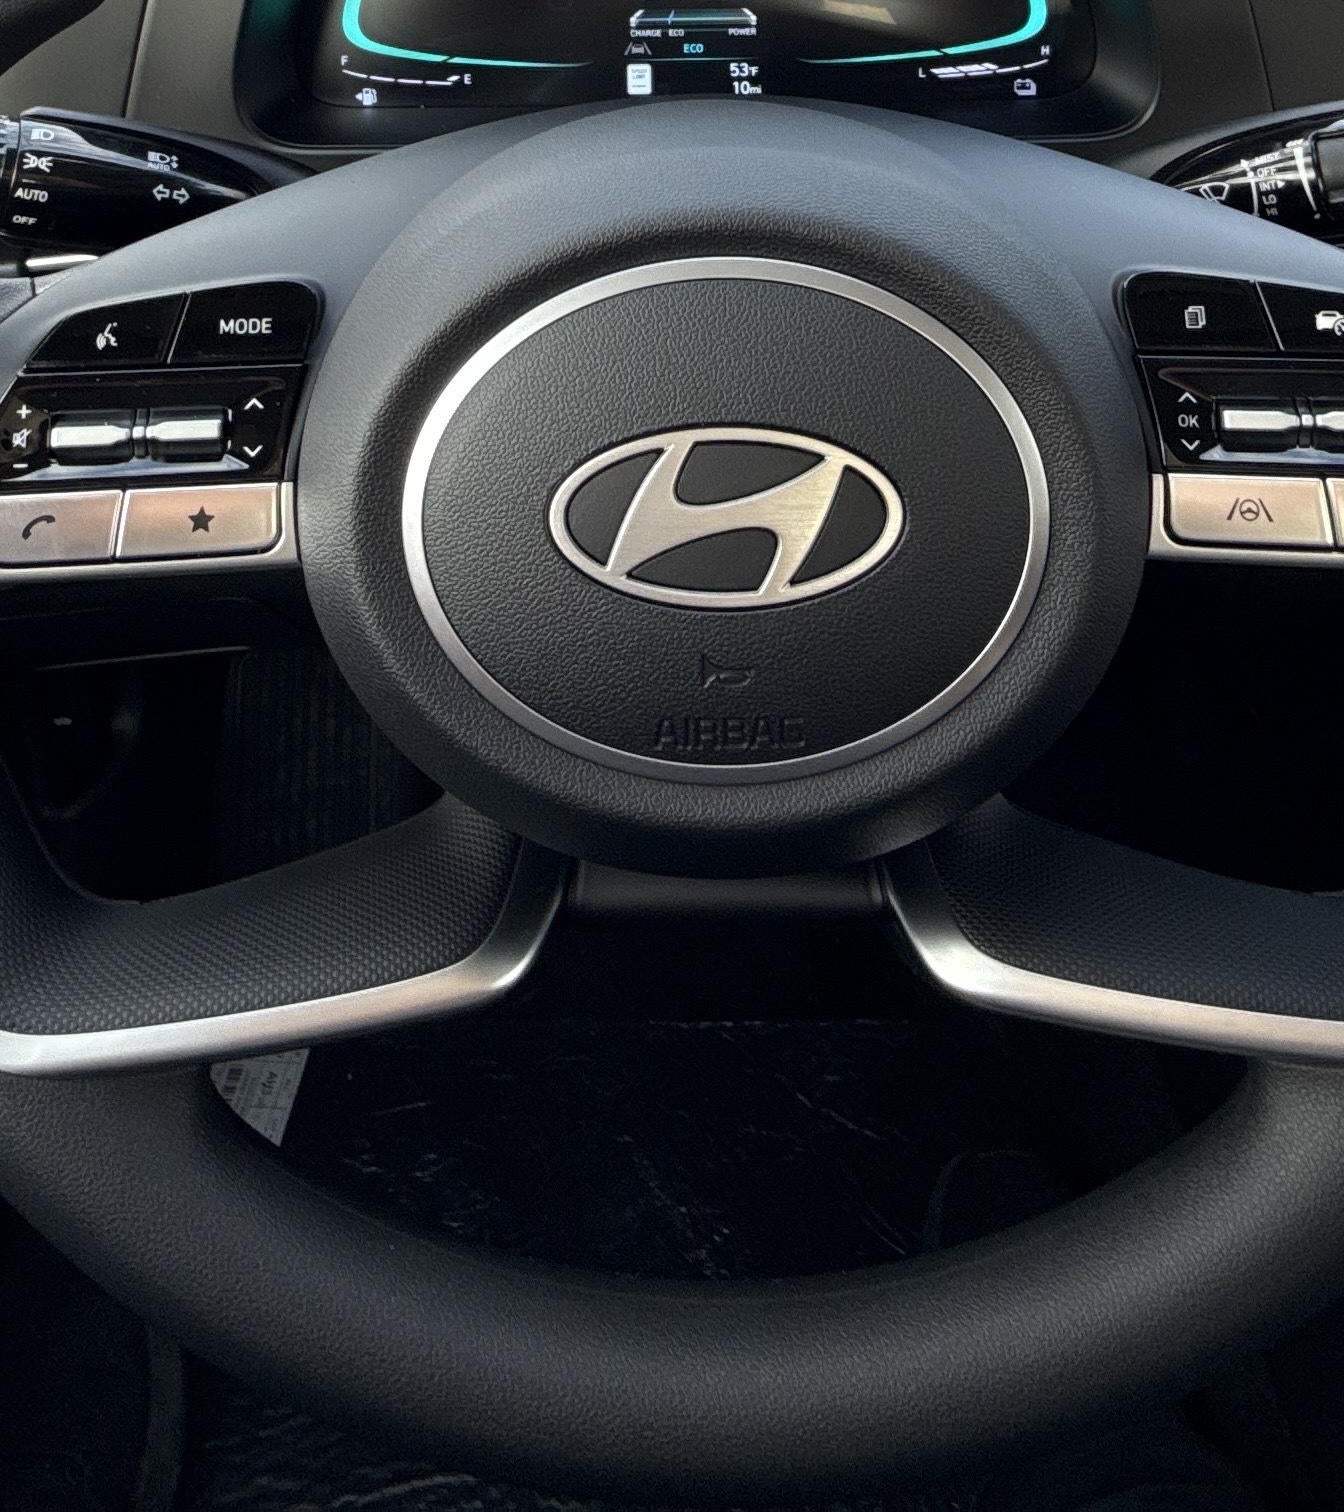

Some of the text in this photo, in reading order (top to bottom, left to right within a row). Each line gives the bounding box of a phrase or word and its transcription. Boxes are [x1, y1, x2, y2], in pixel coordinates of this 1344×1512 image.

[630, 28, 757, 37] CHARGE ECO POWER
[683, 43, 704, 54] ECO
[1040, 44, 1050, 56] H
[340, 54, 349, 66] F
[918, 67, 926, 78] L
[463, 73, 472, 85] E
[1257, 167, 1277, 179] OFF
[1260, 179, 1278, 192] INT
[14, 188, 49, 203] AUTO
[1262, 194, 1277, 205] LO
[12, 215, 38, 225] OFF
[219, 317, 273, 335] MODE
[1178, 414, 1200, 429] OK
[656, 716, 806, 751] AIRBAG
